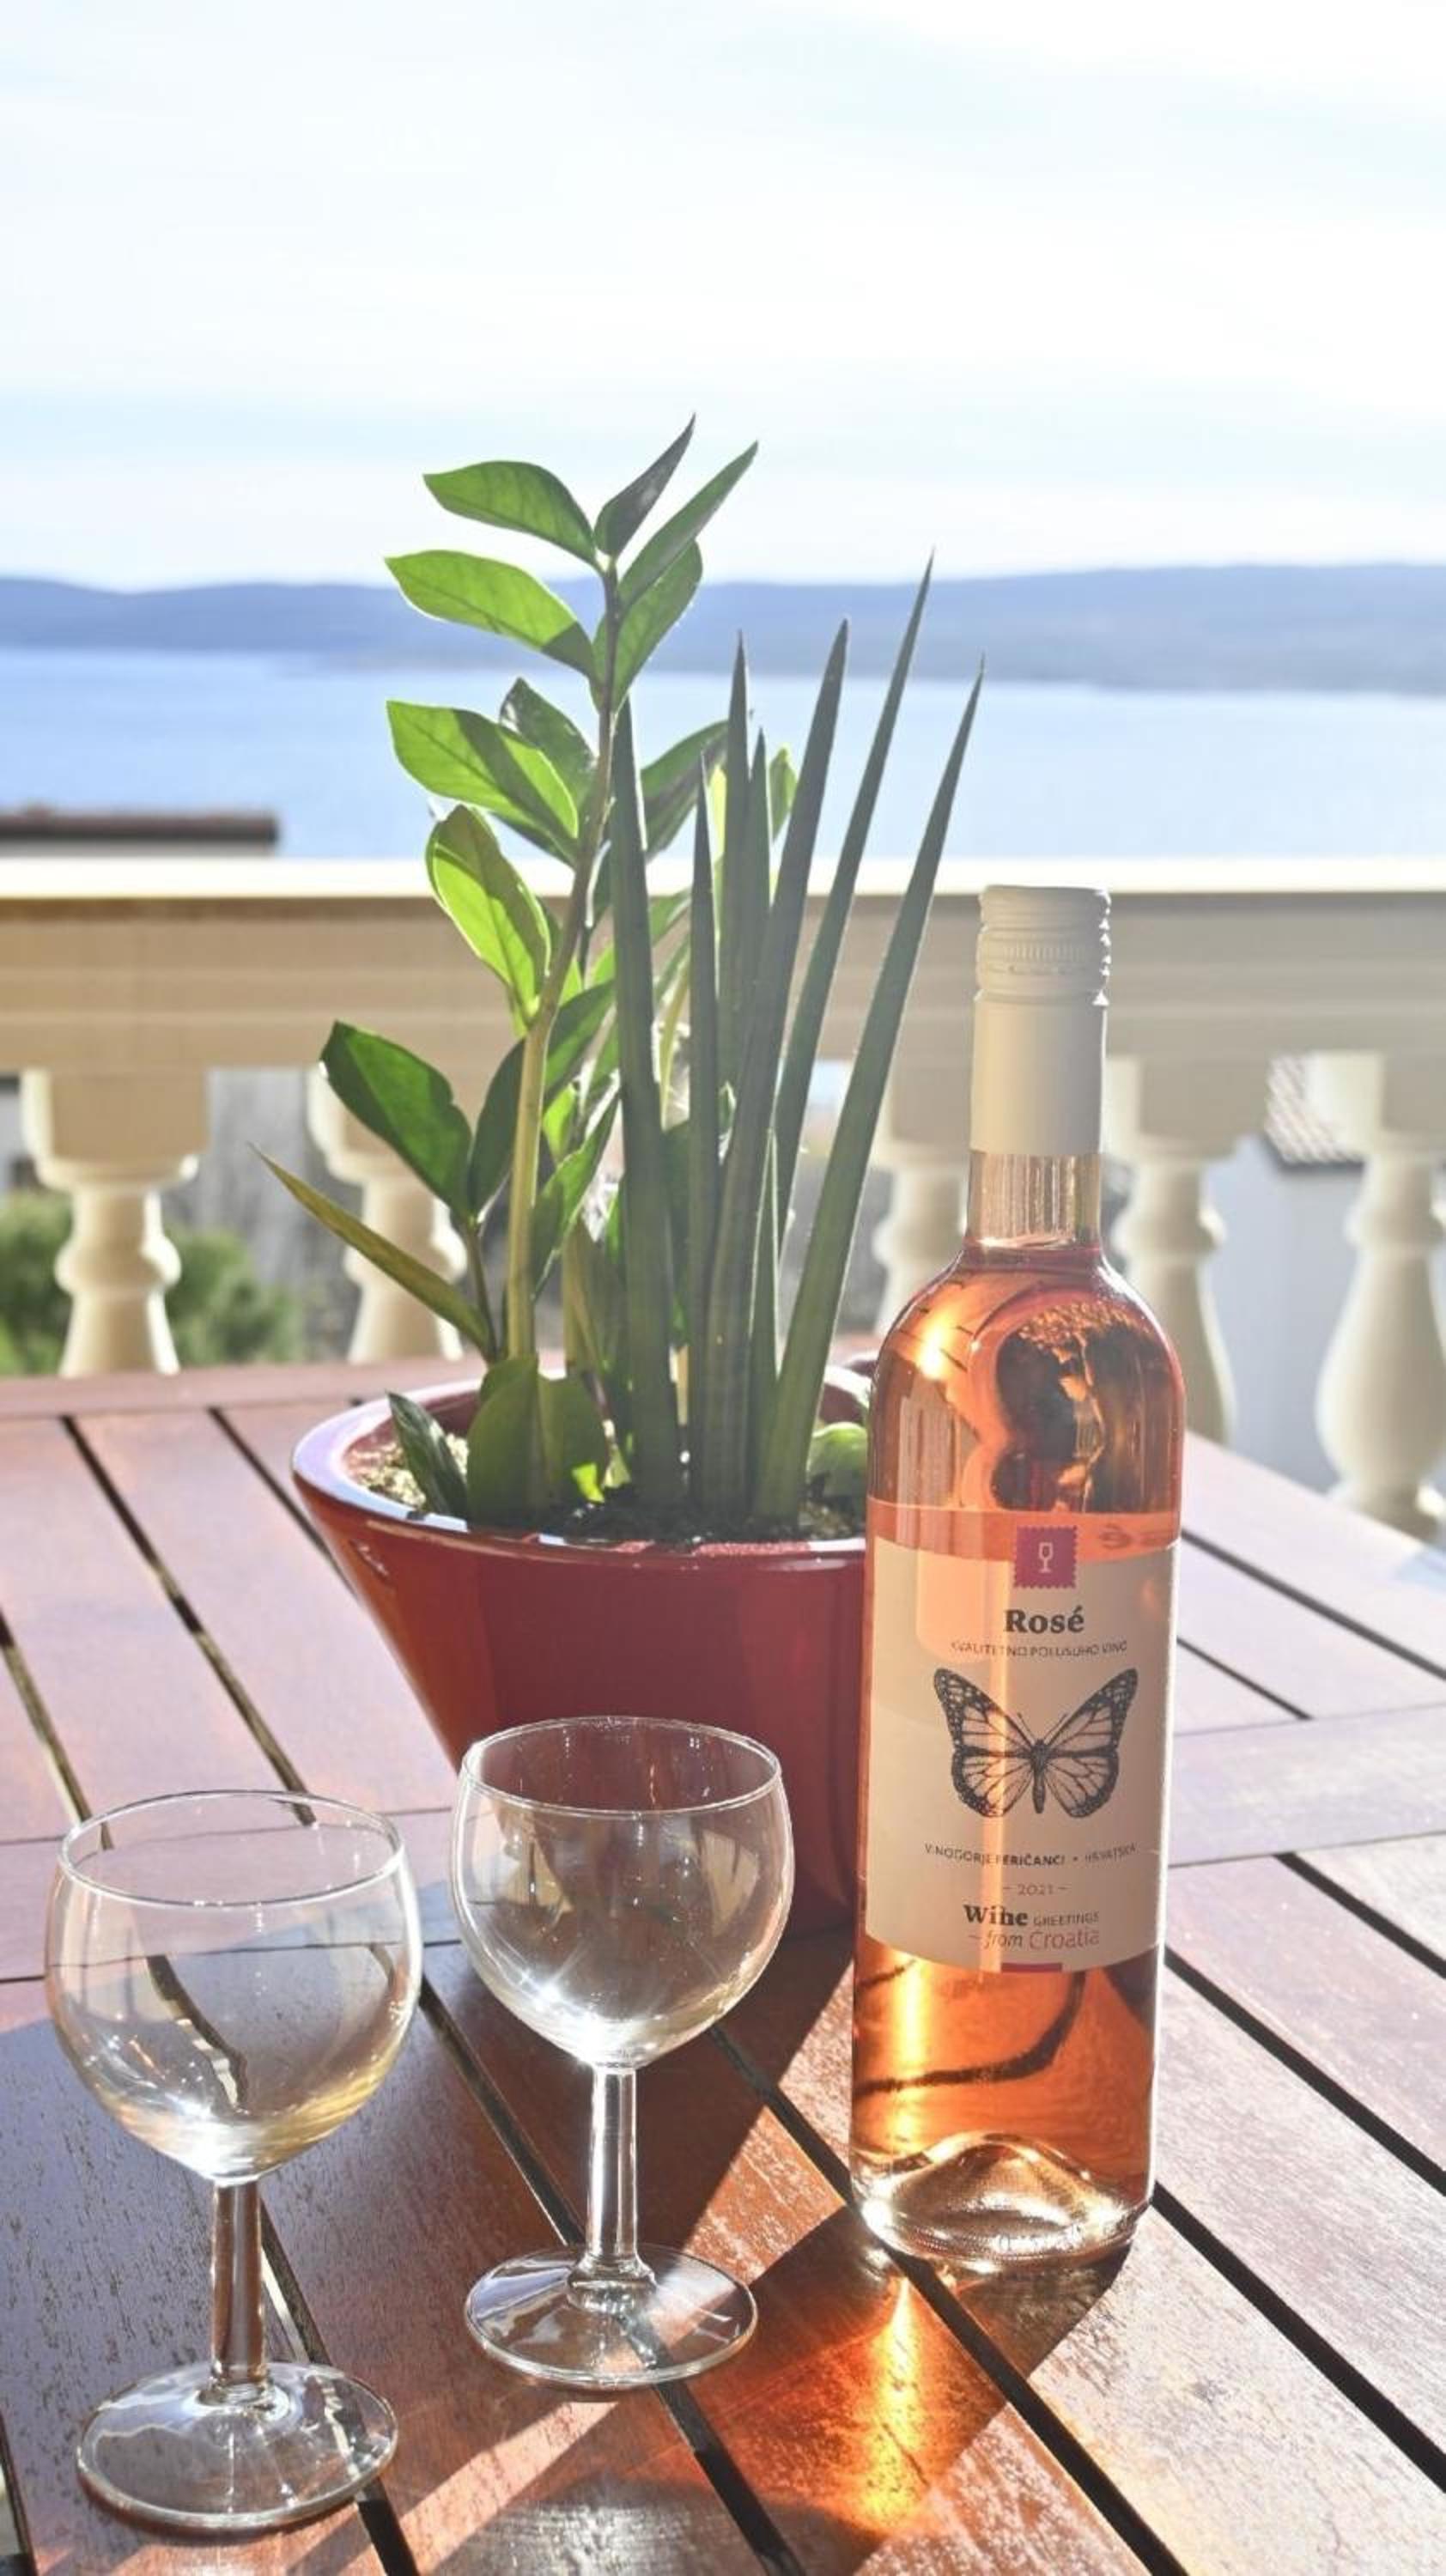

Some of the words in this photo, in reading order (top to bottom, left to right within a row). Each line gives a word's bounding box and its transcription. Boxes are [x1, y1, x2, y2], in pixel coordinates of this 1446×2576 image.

[1004, 1605, 1084, 1634] Rosé
[924, 1844, 992, 1865] VNOGORJE
[1017, 1883, 1054, 1896] 2021
[963, 1904, 1029, 1926] Wine
[983, 1929, 1024, 1950] from
[1029, 1929, 1100, 1950] Croatia
